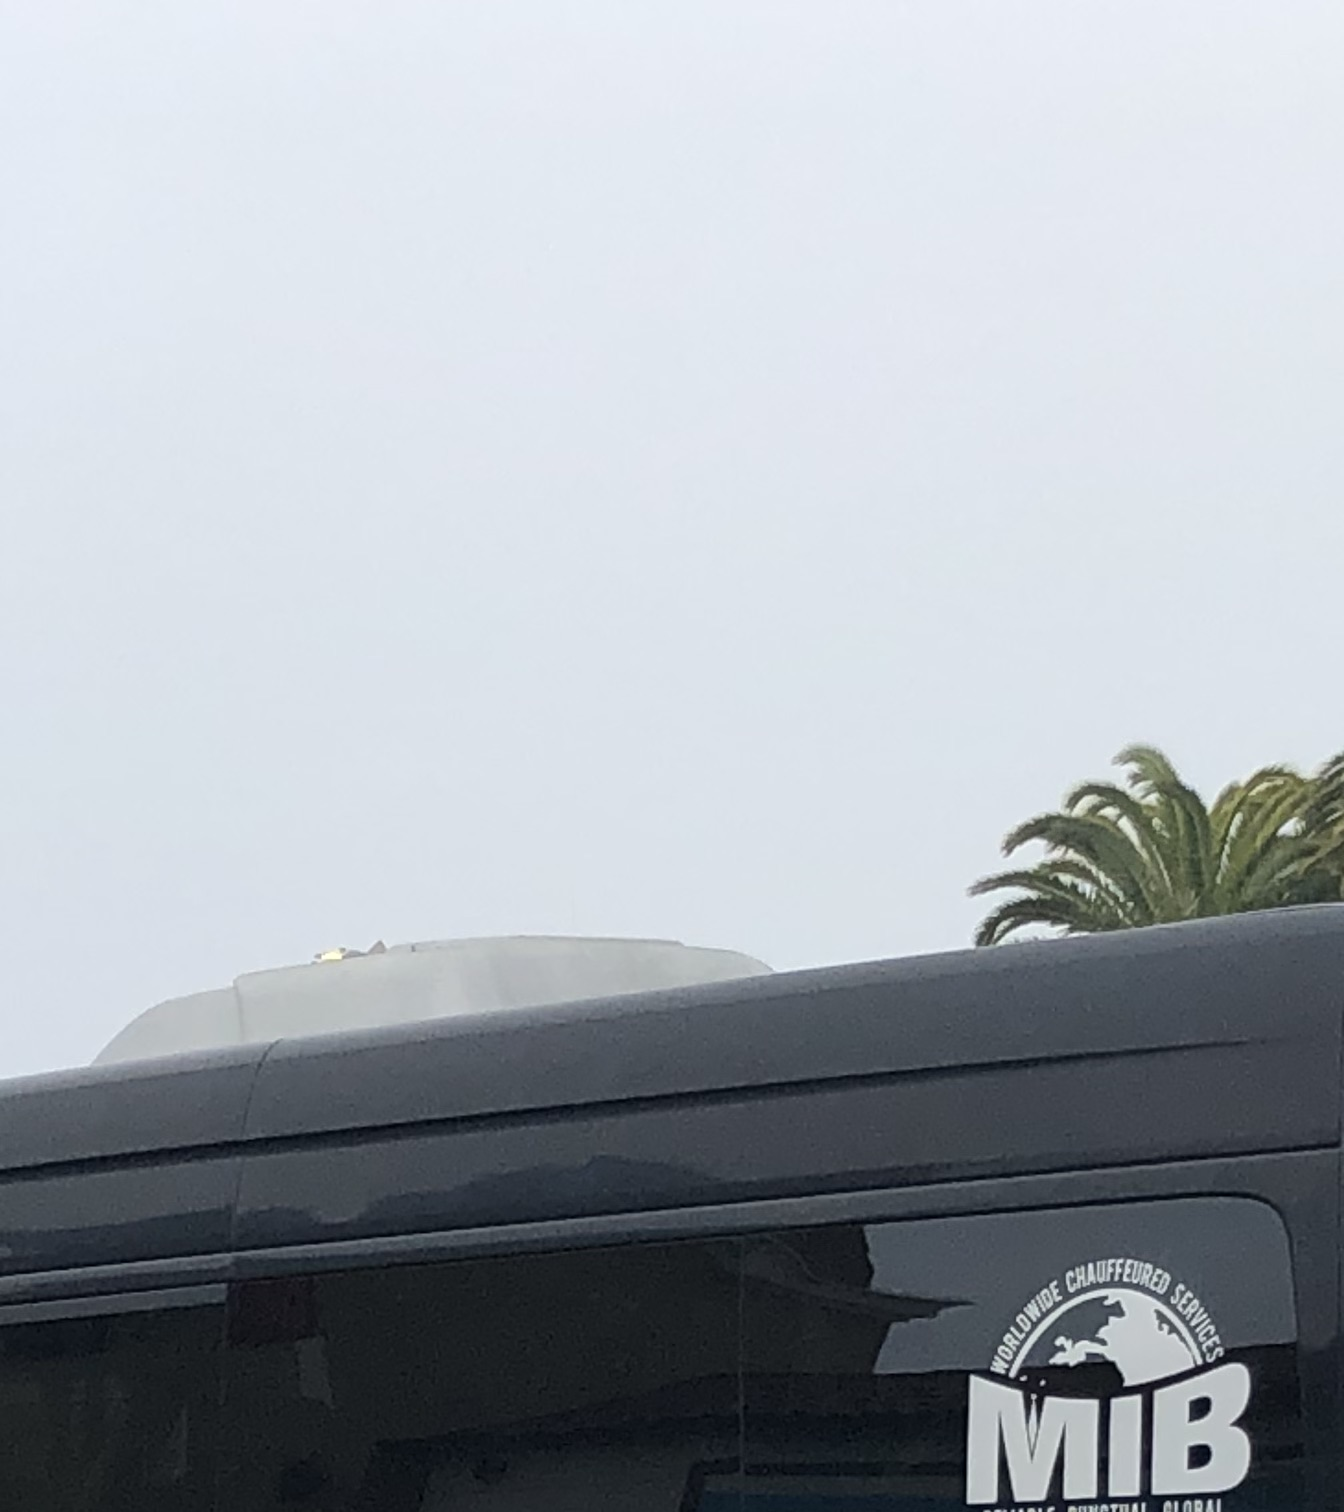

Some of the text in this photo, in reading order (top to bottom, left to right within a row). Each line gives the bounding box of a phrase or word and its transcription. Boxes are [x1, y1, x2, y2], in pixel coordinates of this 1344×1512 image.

[989, 1257, 1225, 1376] WORLDWIDE CHAUFFEURED SERVICES
[966, 1362, 1252, 1505] MIB
